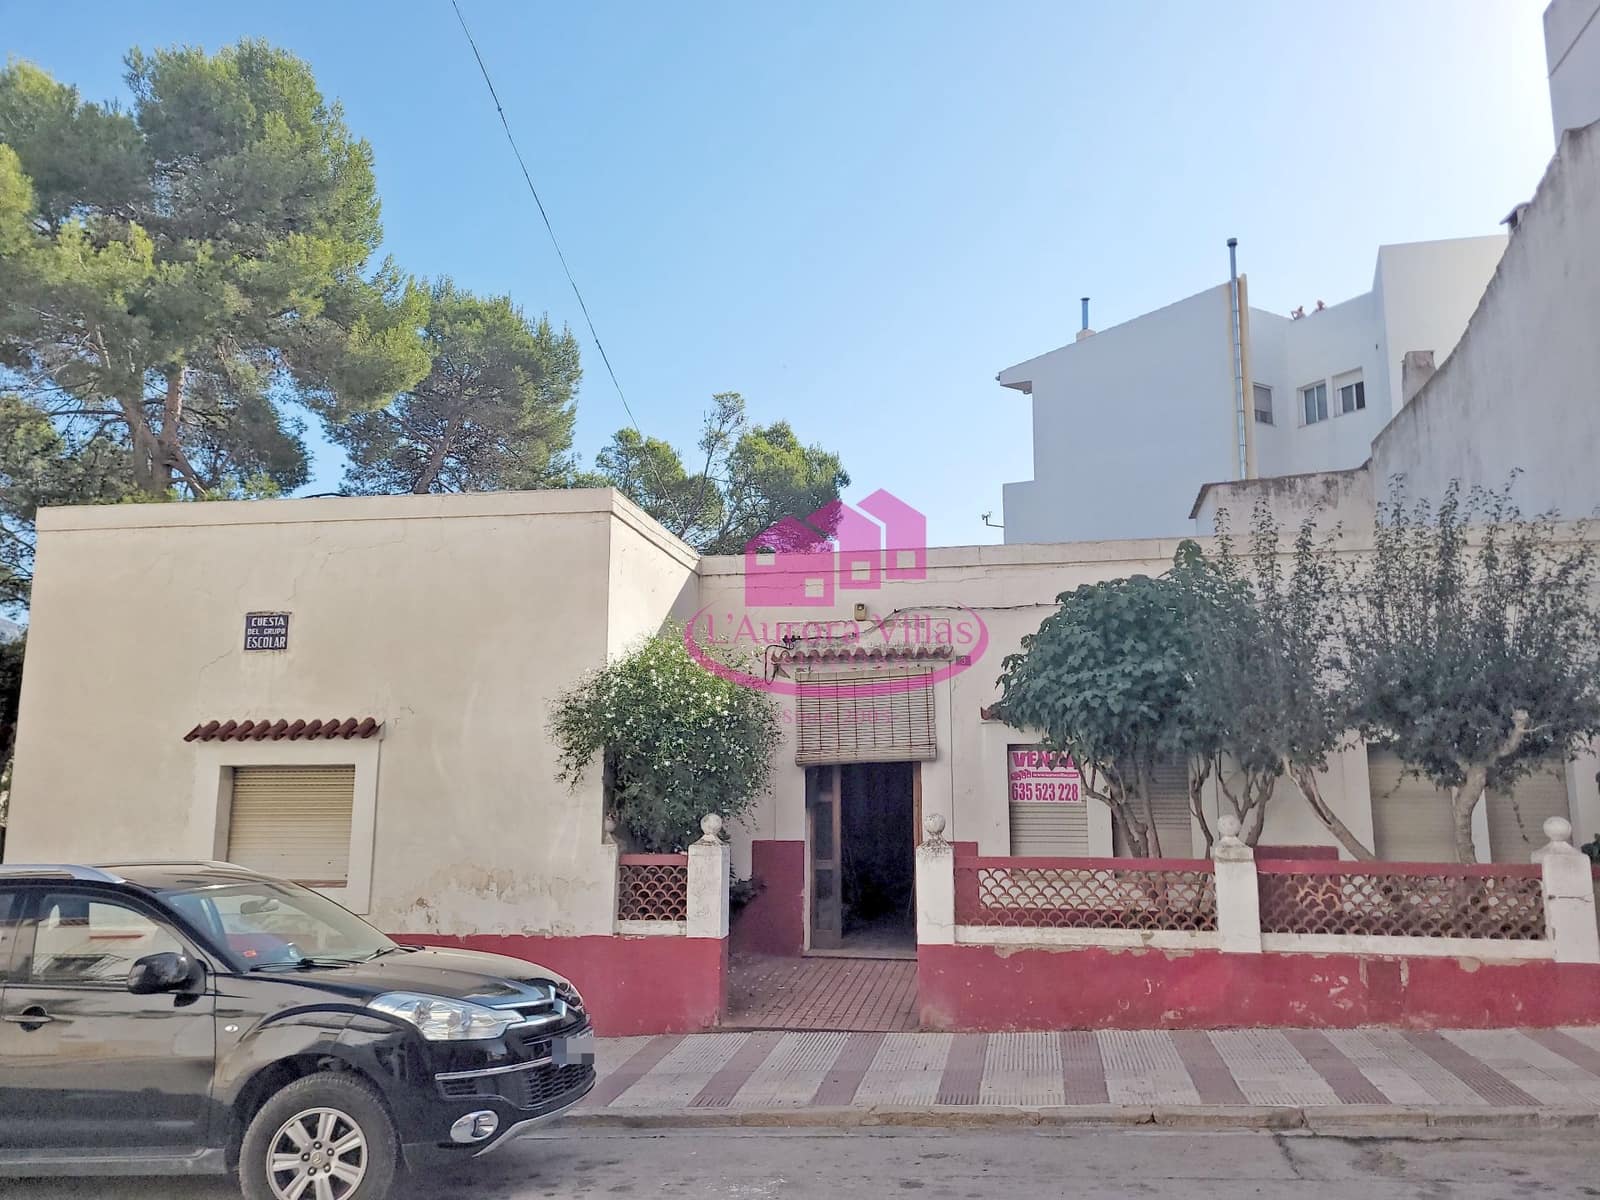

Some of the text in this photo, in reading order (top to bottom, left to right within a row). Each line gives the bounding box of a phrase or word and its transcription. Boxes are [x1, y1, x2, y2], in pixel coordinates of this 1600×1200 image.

[251, 616, 285, 627] CUESTA
[246, 636, 286, 649] ESCOLAR
[1012, 751, 1076, 768] VENA
[1011, 782, 1079, 802] 635 523 228
